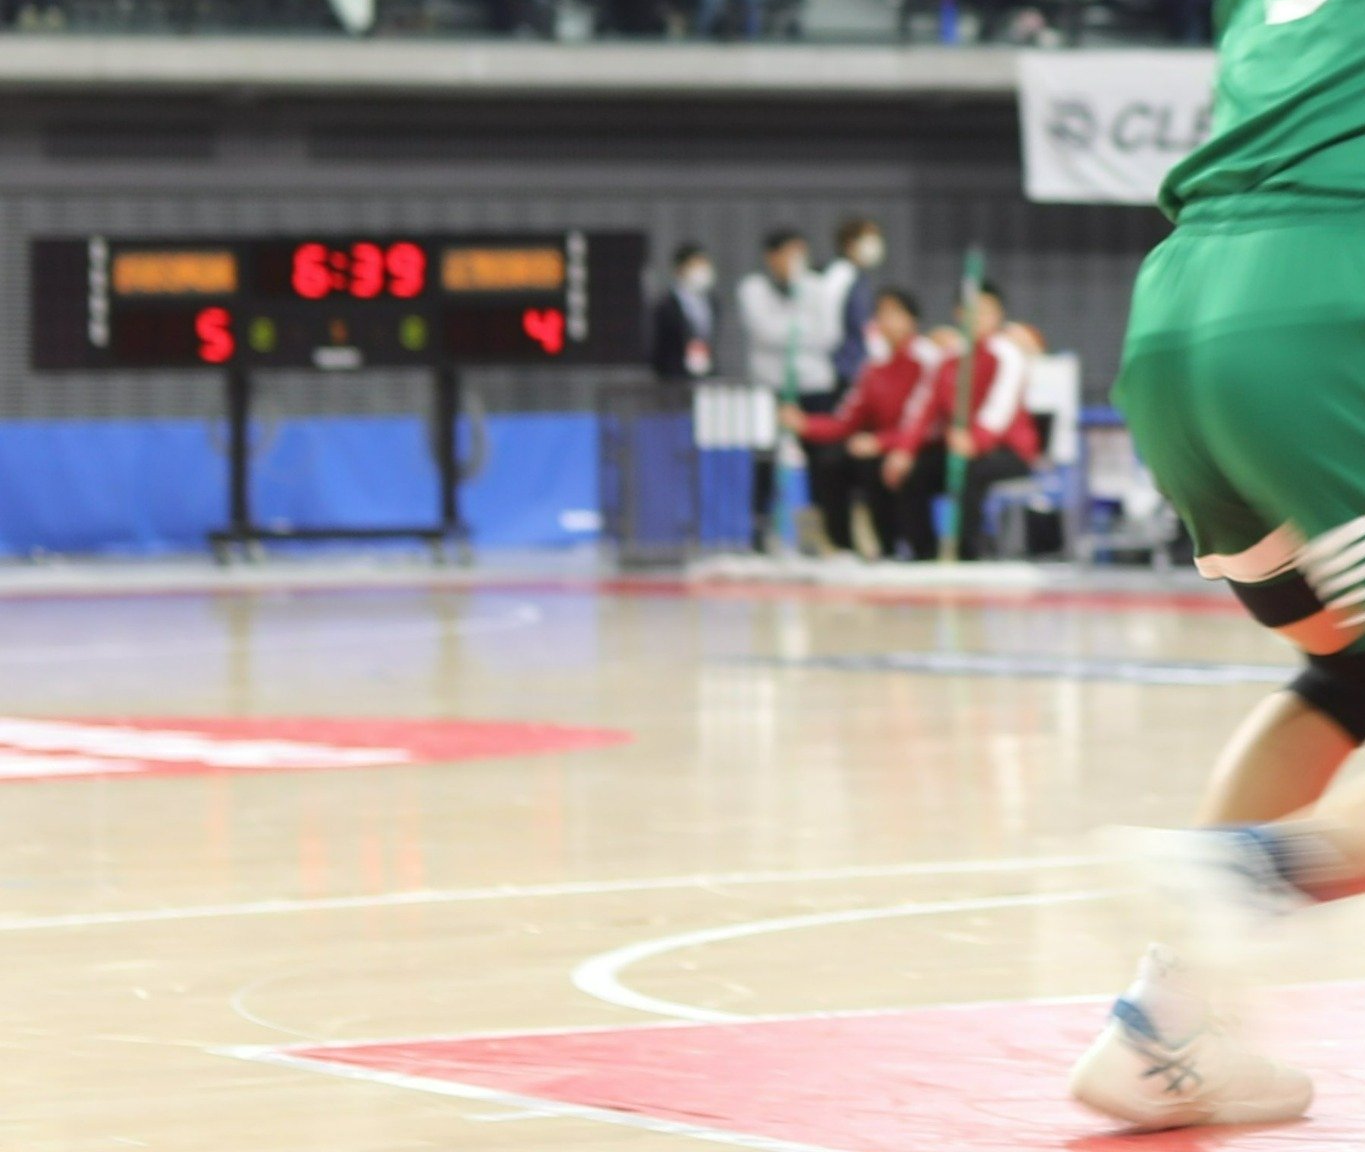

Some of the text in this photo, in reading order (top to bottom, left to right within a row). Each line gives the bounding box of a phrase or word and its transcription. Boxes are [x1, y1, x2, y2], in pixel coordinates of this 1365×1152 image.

[293, 243, 426, 298] 6:39
[195, 306, 235, 364] 5
[522, 307, 565, 355] 4
